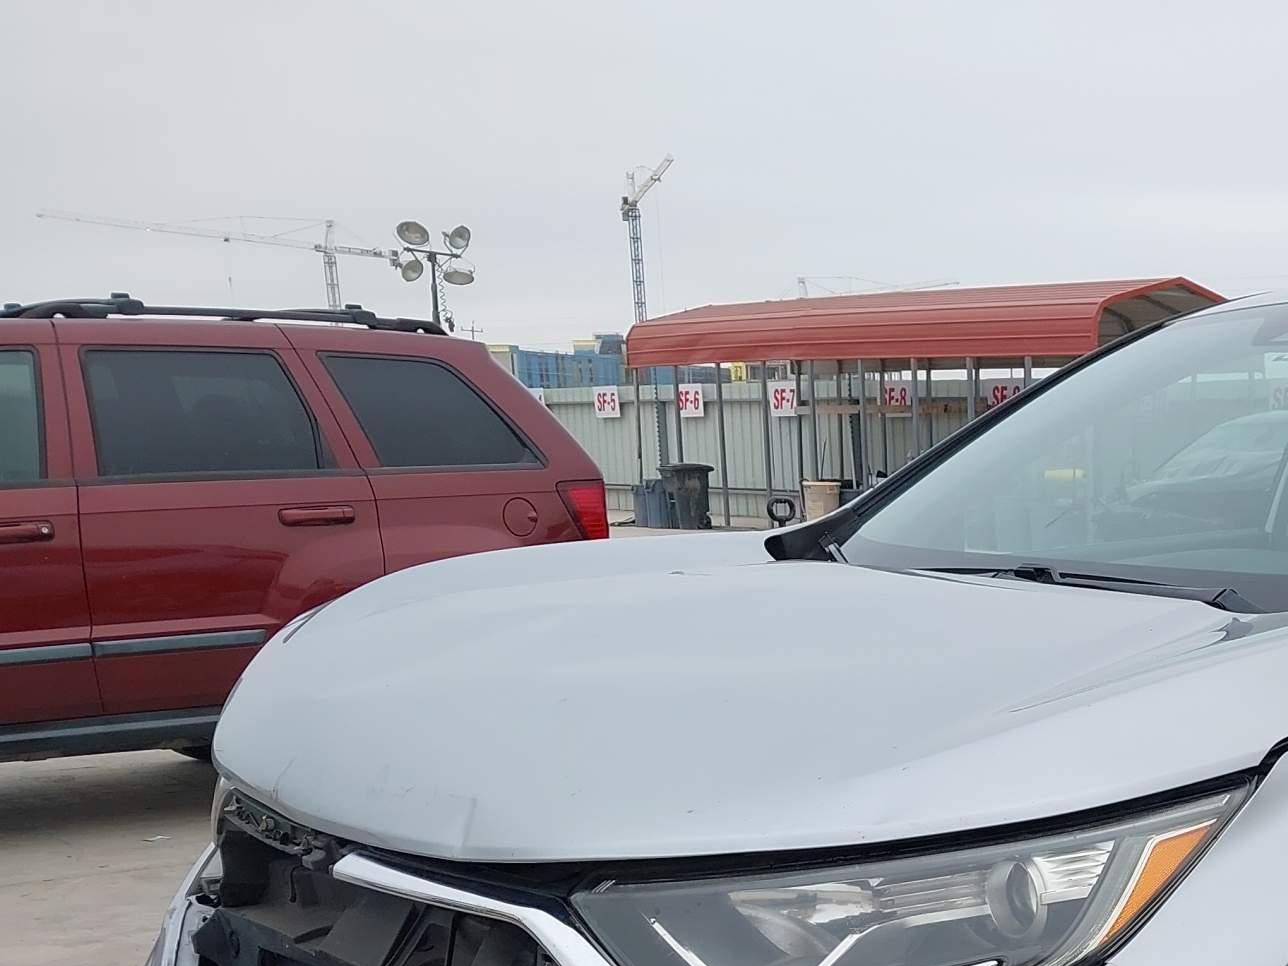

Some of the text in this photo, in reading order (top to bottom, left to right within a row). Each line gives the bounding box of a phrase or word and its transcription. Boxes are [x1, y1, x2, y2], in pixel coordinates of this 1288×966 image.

[597, 392, 616, 412] SF-5
[678, 390, 699, 410] SF-6
[773, 388, 796, 410] SF-7
